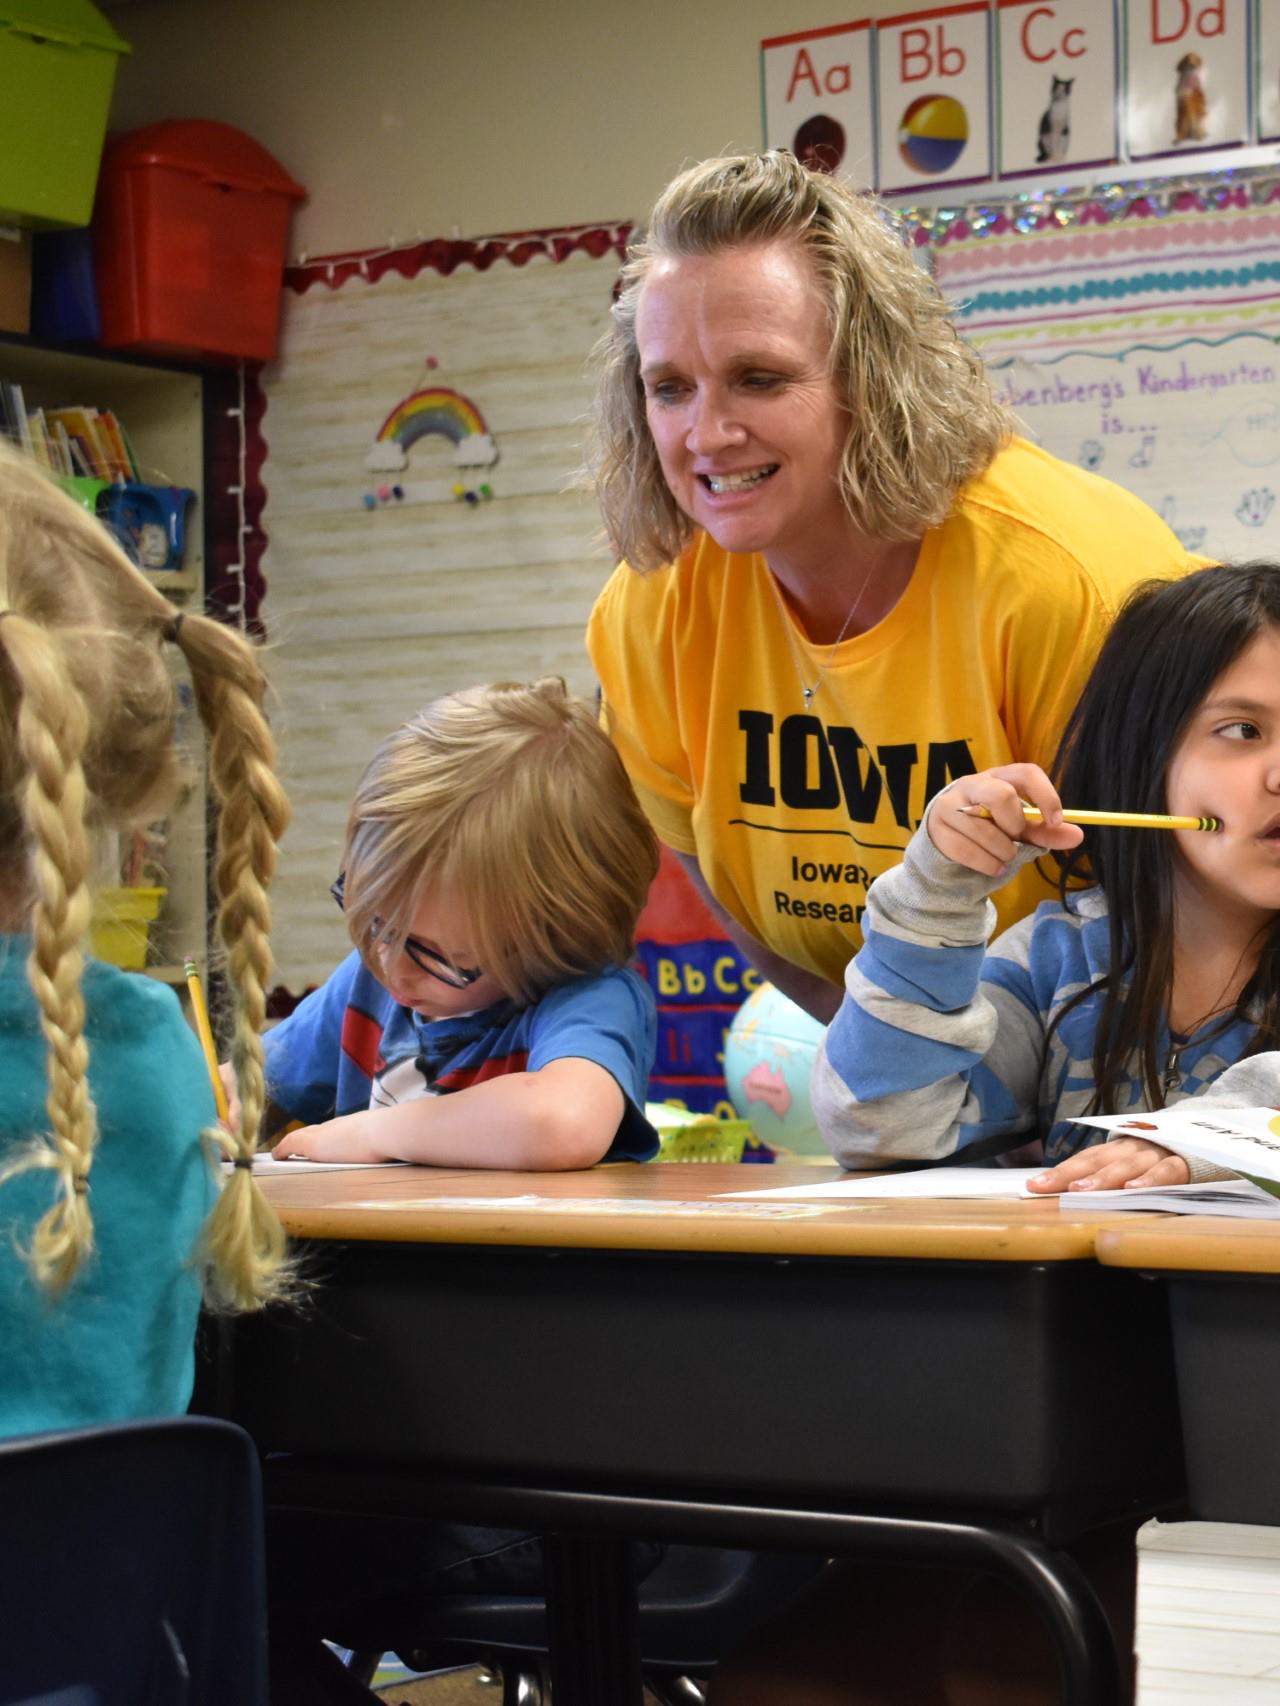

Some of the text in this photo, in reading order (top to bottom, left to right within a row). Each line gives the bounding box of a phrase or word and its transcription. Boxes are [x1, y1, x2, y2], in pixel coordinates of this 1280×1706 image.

[900, 24, 967, 84] Bb
[1020, 6, 1089, 64] Cc
[785, 47, 852, 104] Aa
[738, 709, 979, 831] IOWA
[791, 856, 860, 884] Iowa
[657, 958, 706, 997] Bb
[713, 955, 763, 994] Cc
